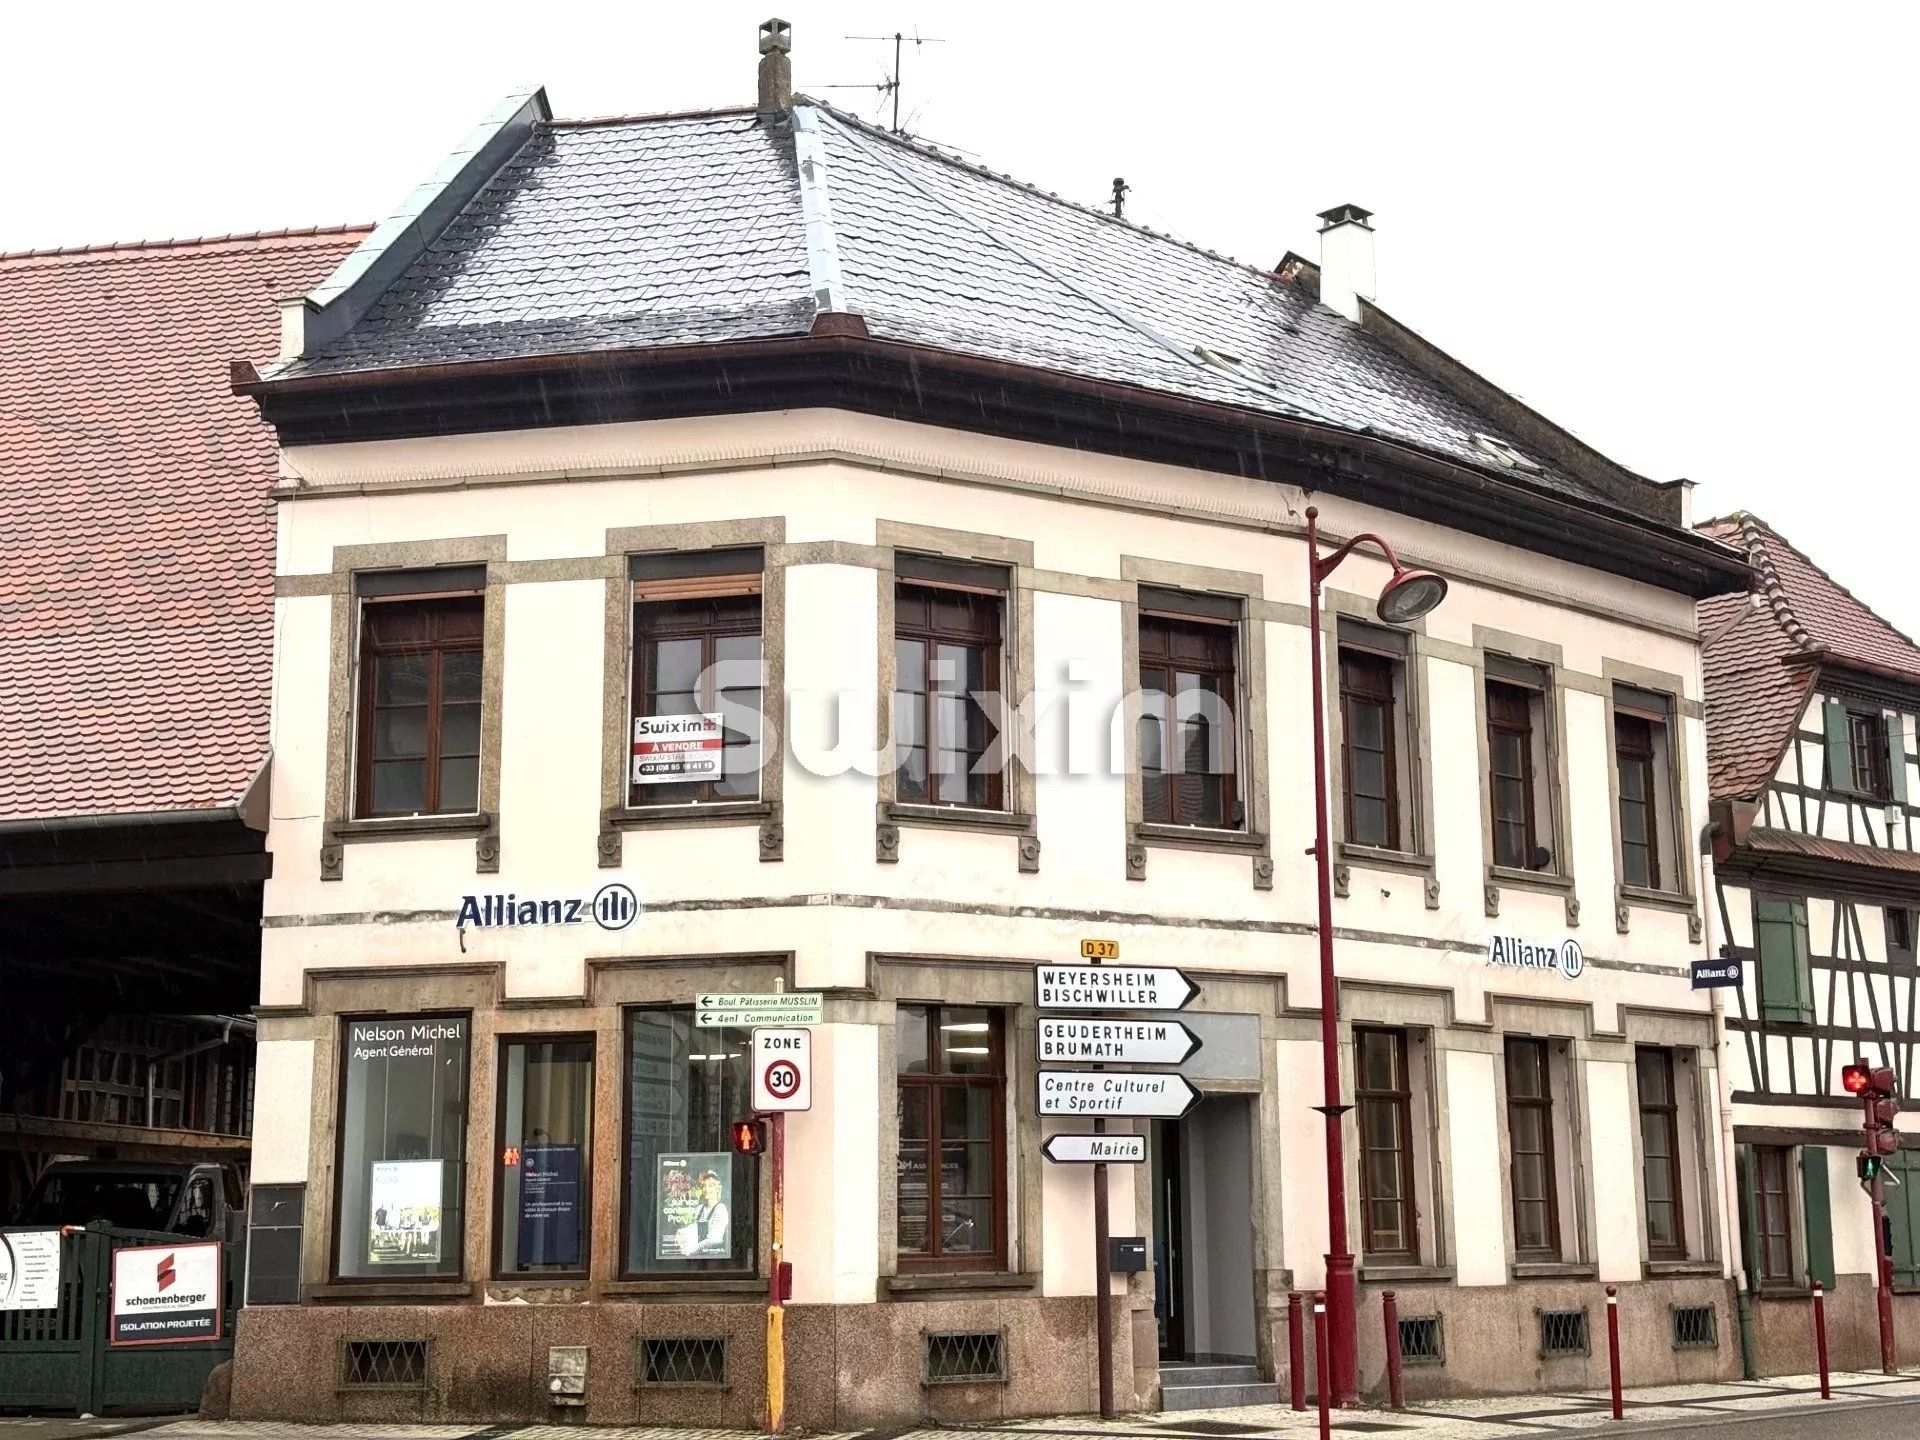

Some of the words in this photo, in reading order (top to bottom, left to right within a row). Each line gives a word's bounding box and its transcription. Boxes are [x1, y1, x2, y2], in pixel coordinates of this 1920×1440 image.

[639, 719, 701, 735] Swixim
[662, 741, 703, 751] VENDRE
[456, 893, 582, 927] Allianz
[1086, 942, 1094, 955] D
[1098, 943, 1115, 956] 37
[1491, 935, 1557, 968] Allianz
[1043, 971, 1156, 987] WEYERSHEIM
[1696, 968, 1726, 979] Allianz
[780, 996, 818, 1006] MUSSLIN
[1043, 988, 1158, 1004] BISCHWILLER
[744, 1013, 814, 1023] Communication
[354, 1026, 405, 1042] Nelson
[411, 1024, 461, 1040] Michel
[1044, 1024, 1167, 1041] GEUDERTHEIM
[764, 1037, 801, 1049] ZONE
[1044, 1042, 1124, 1057] BRUMATH
[354, 1046, 387, 1060] Agent
[389, 1044, 434, 1057] Général
[772, 1070, 794, 1088] 30
[1045, 1078, 1095, 1092] Centre
[1103, 1079, 1166, 1093] Culturel
[1045, 1097, 1060, 1109] et
[1069, 1096, 1123, 1112] Sportif
[1090, 1142, 1139, 1156] Mairie
[126, 1293, 207, 1306] schoenenberger
[120, 1321, 165, 1331] ISOLATION
[167, 1316, 211, 1329] PROJETÉE
